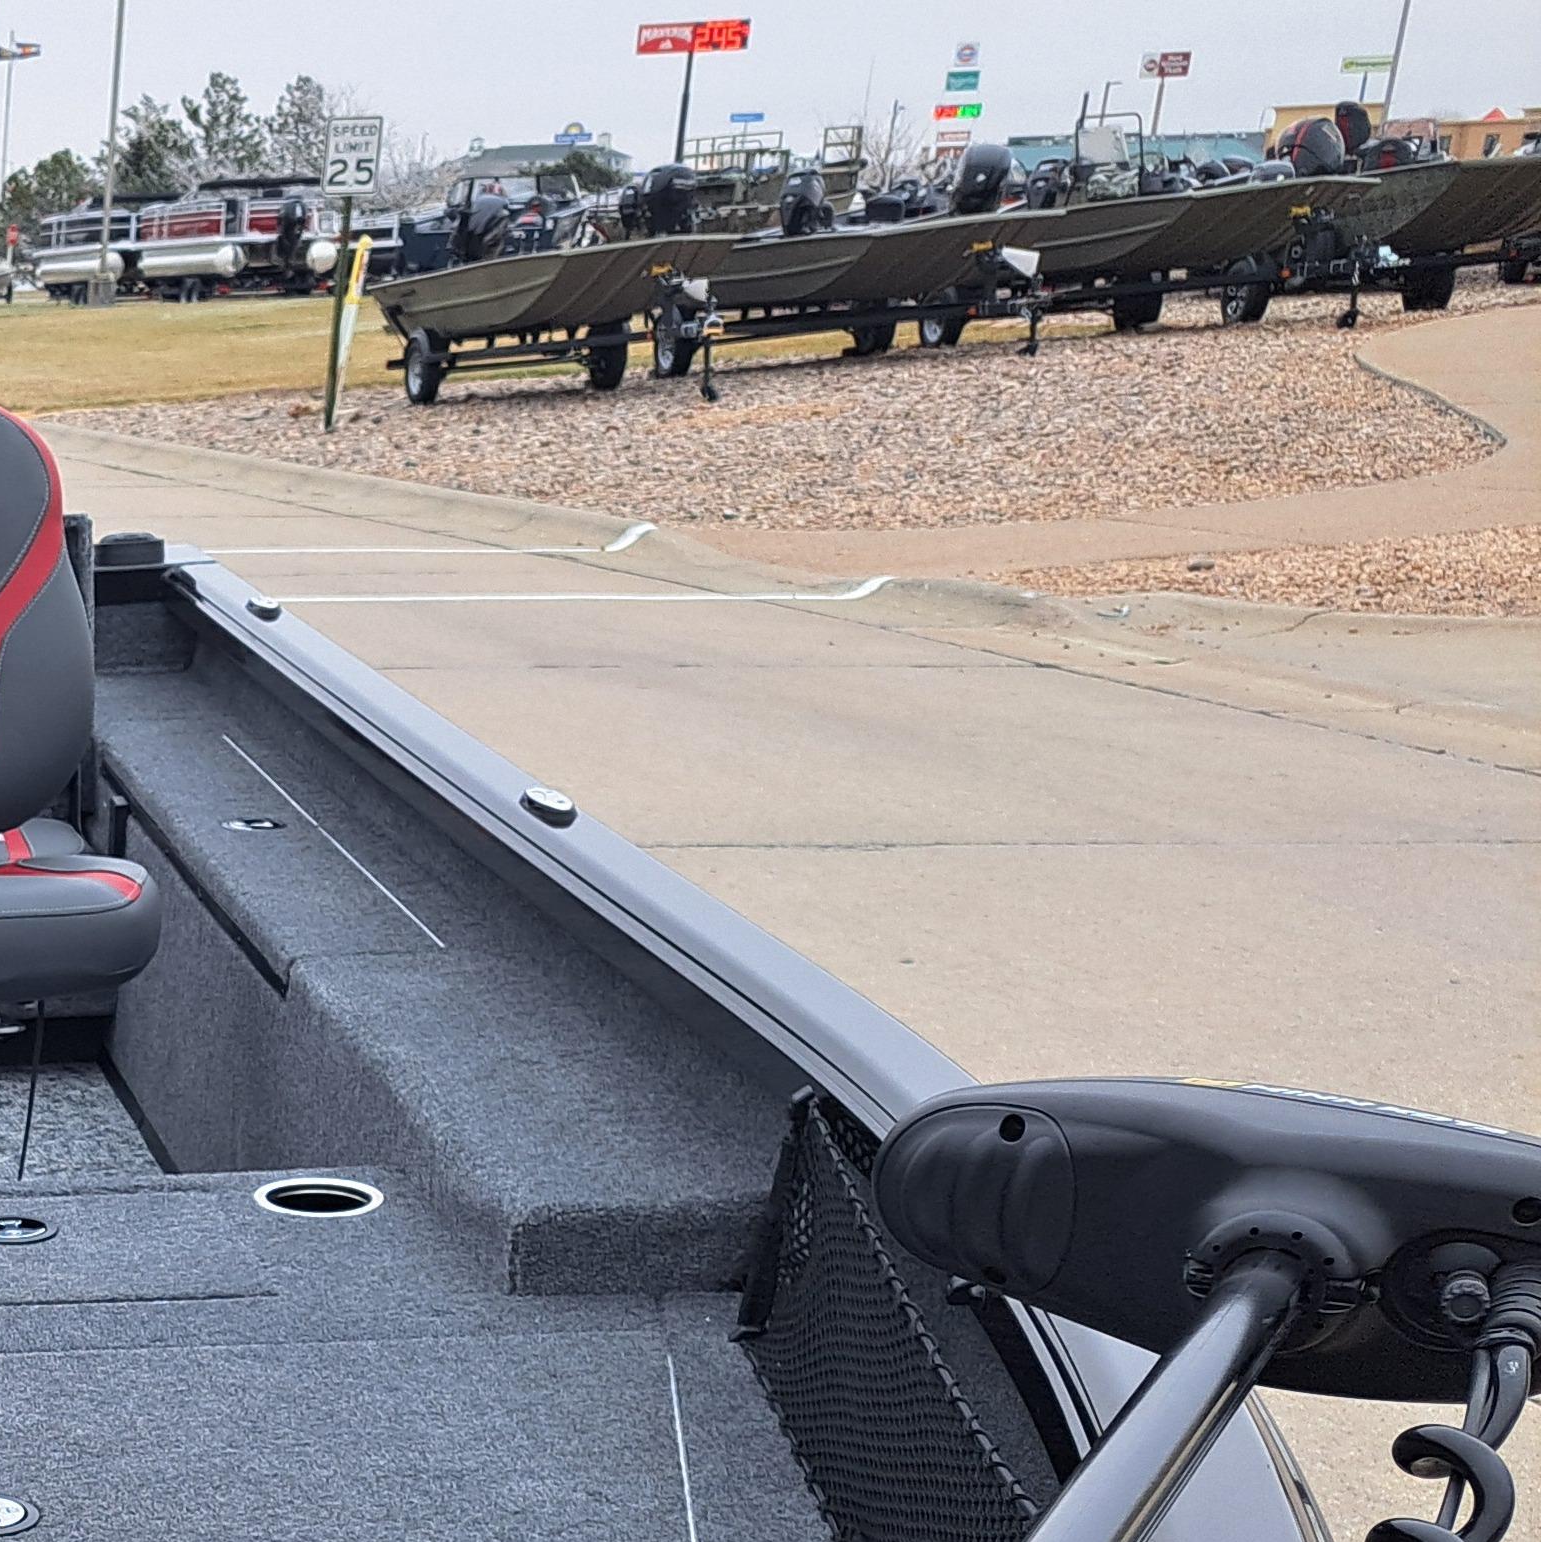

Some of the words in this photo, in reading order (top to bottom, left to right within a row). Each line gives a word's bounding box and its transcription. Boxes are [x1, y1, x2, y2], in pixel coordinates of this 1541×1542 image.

[332, 125, 378, 137] SPEED
[335, 141, 373, 153] LIMIT
[328, 158, 375, 186] 25
